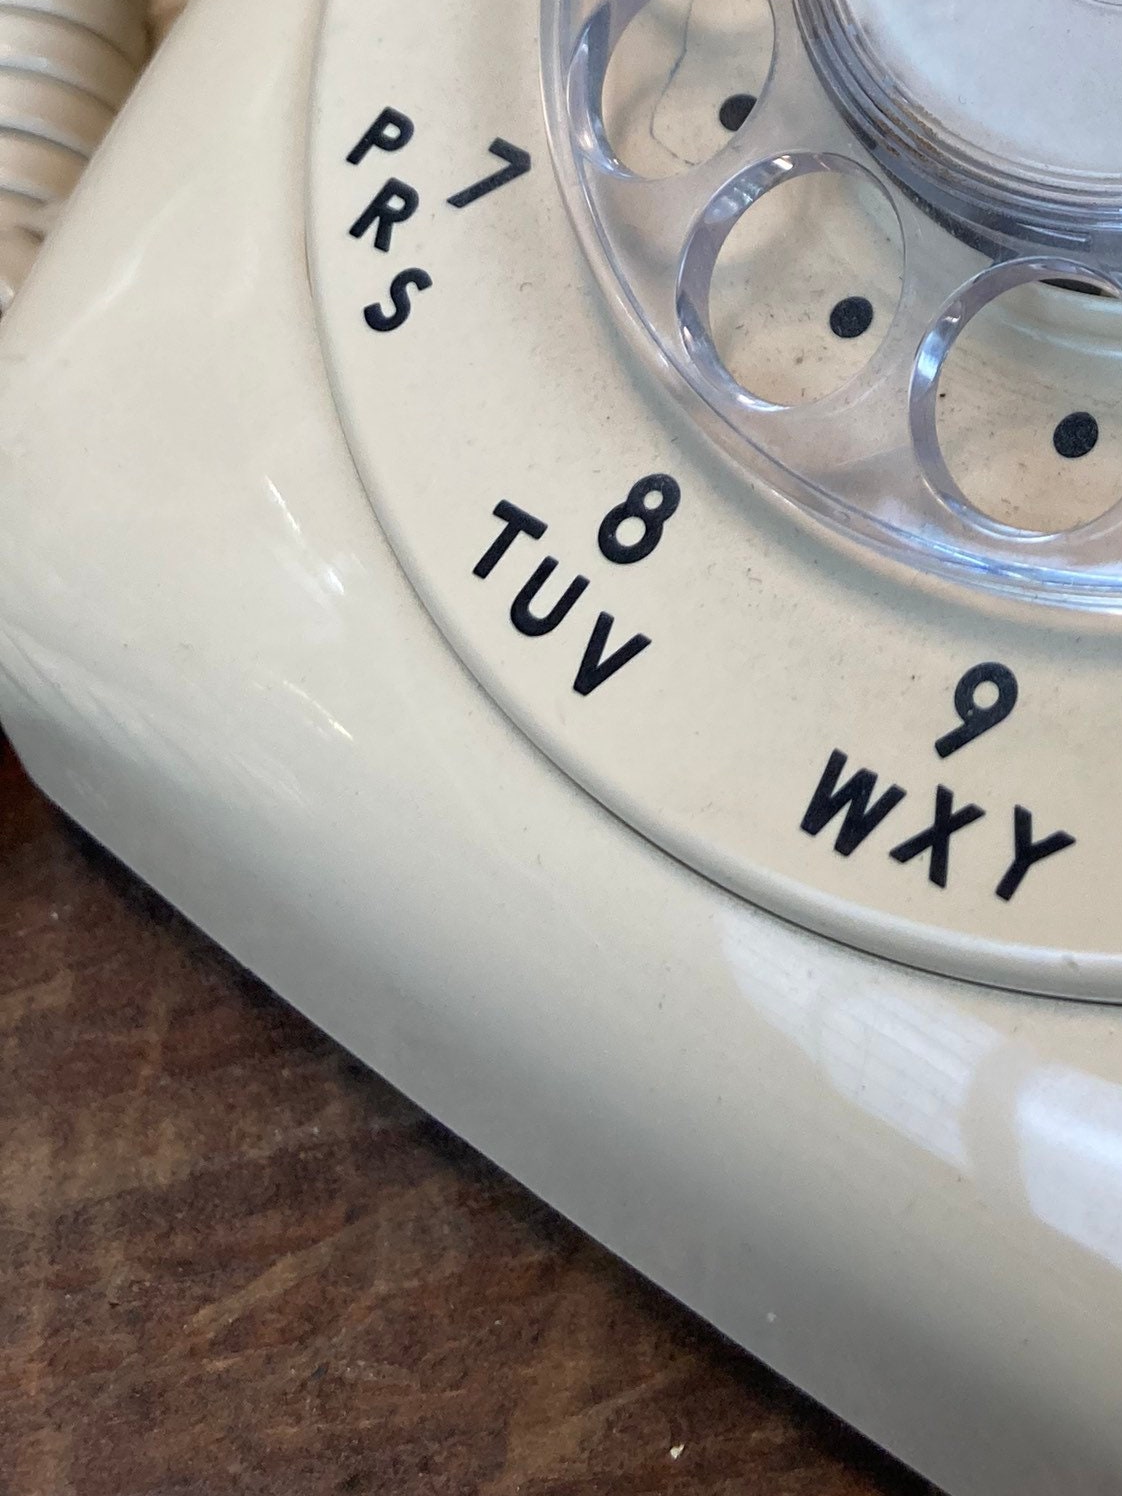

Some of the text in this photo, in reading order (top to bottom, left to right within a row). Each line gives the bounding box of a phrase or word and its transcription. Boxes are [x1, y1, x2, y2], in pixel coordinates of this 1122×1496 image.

[344, 106, 434, 334] PRS
[445, 136, 532, 210] 7
[597, 472, 682, 566] 8
[471, 498, 653, 698] TUV
[933, 661, 1020, 761] 9
[798, 747, 1077, 903] WXY
